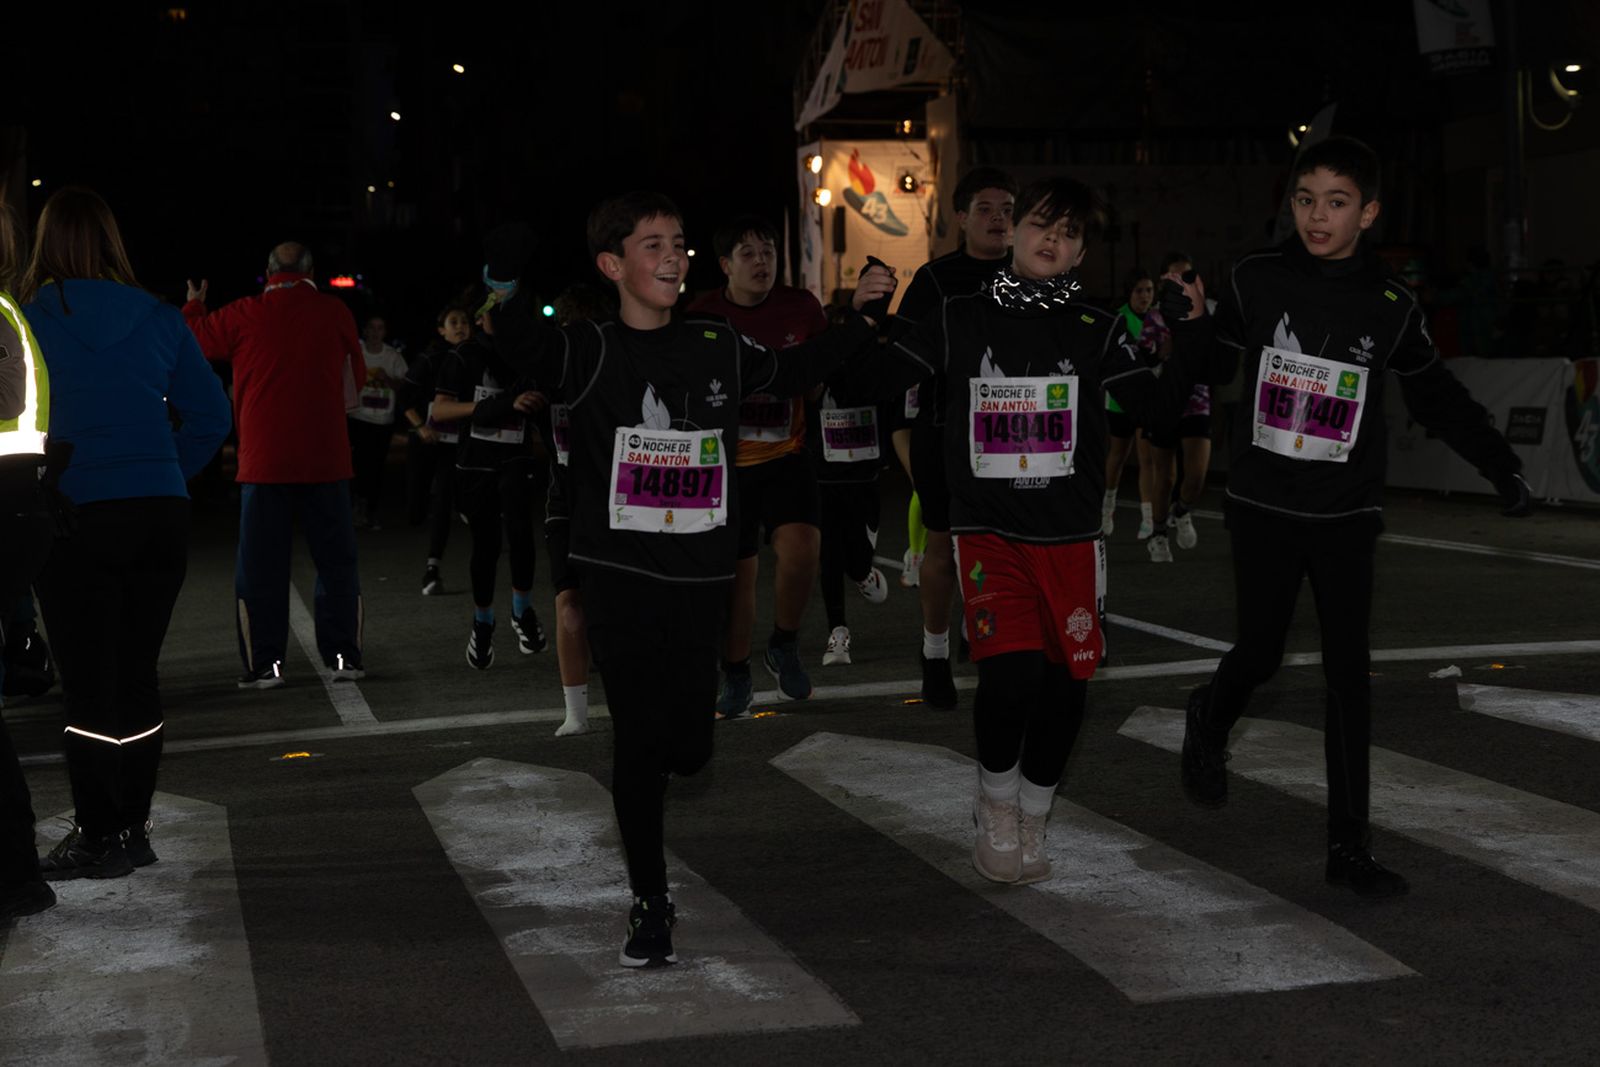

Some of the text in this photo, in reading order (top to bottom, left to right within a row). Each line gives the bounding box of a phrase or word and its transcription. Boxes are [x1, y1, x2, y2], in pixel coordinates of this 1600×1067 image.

[861, 198, 889, 224] 43
[1282, 363, 1316, 379] NOCHE
[1316, 370, 1330, 382] DE
[1269, 372, 1289, 386] SAN
[1290, 377, 1328, 394] ANTÓN
[991, 389, 1022, 399] NOCHE
[1024, 389, 1037, 399] DE
[980, 401, 1000, 412] SAN
[1001, 399, 1038, 412] ANTÓN
[981, 413, 1065, 443] 14946
[642, 441, 678, 453] NOCHE
[679, 442, 692, 453] DE
[627, 452, 651, 464] SAN
[652, 451, 691, 466] ANTÓN
[630, 466, 714, 498] 14897
[1073, 648, 1095, 662] vive
